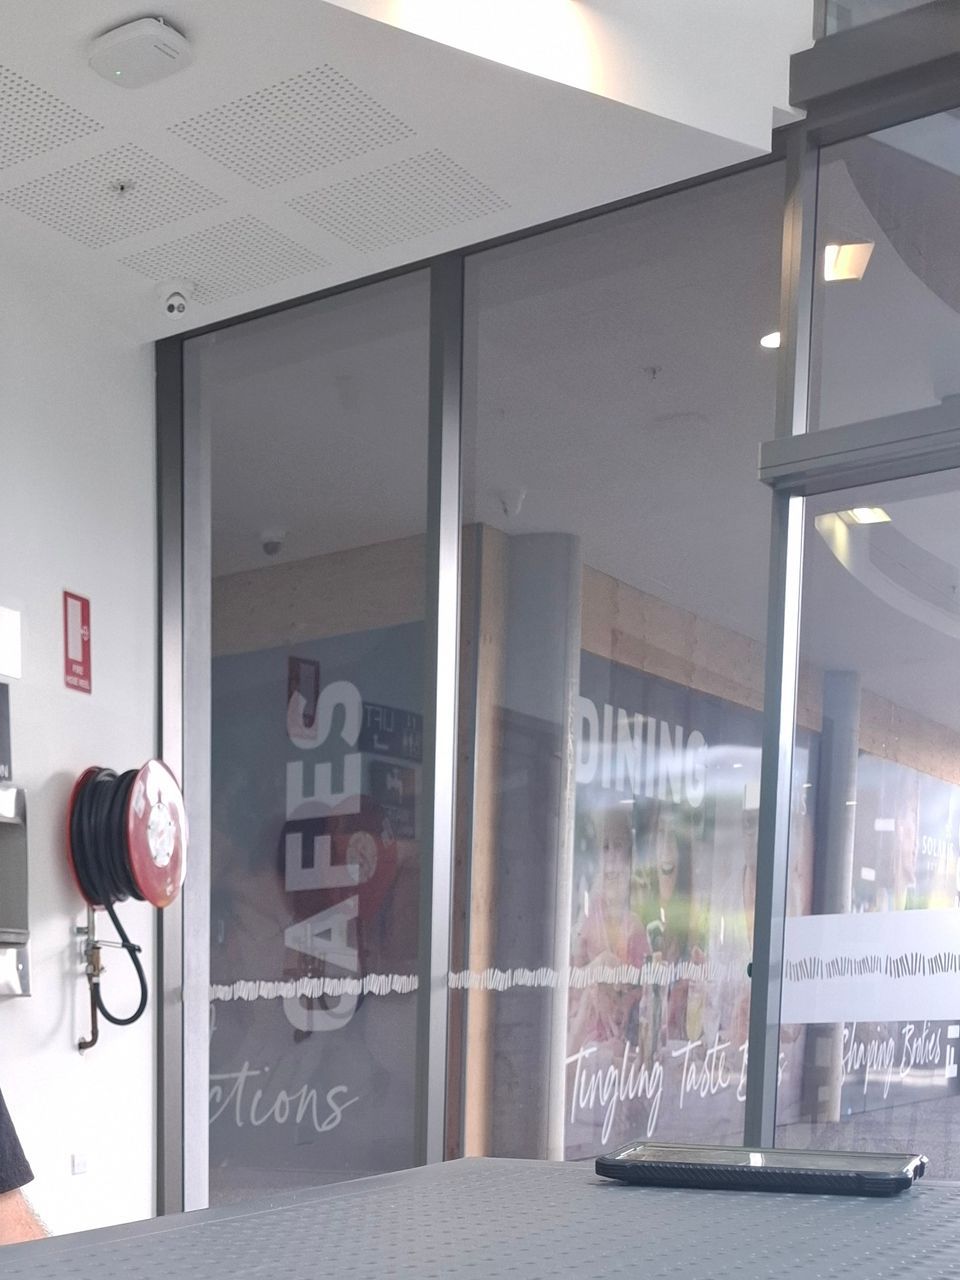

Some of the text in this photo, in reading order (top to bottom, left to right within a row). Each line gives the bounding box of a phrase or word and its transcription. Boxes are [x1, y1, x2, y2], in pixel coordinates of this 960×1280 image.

[575, 695, 707, 808] DINING
[283, 679, 363, 1032] CAFES
[565, 1041, 664, 1145] Tingling
[672, 1032, 731, 1109] Taste
